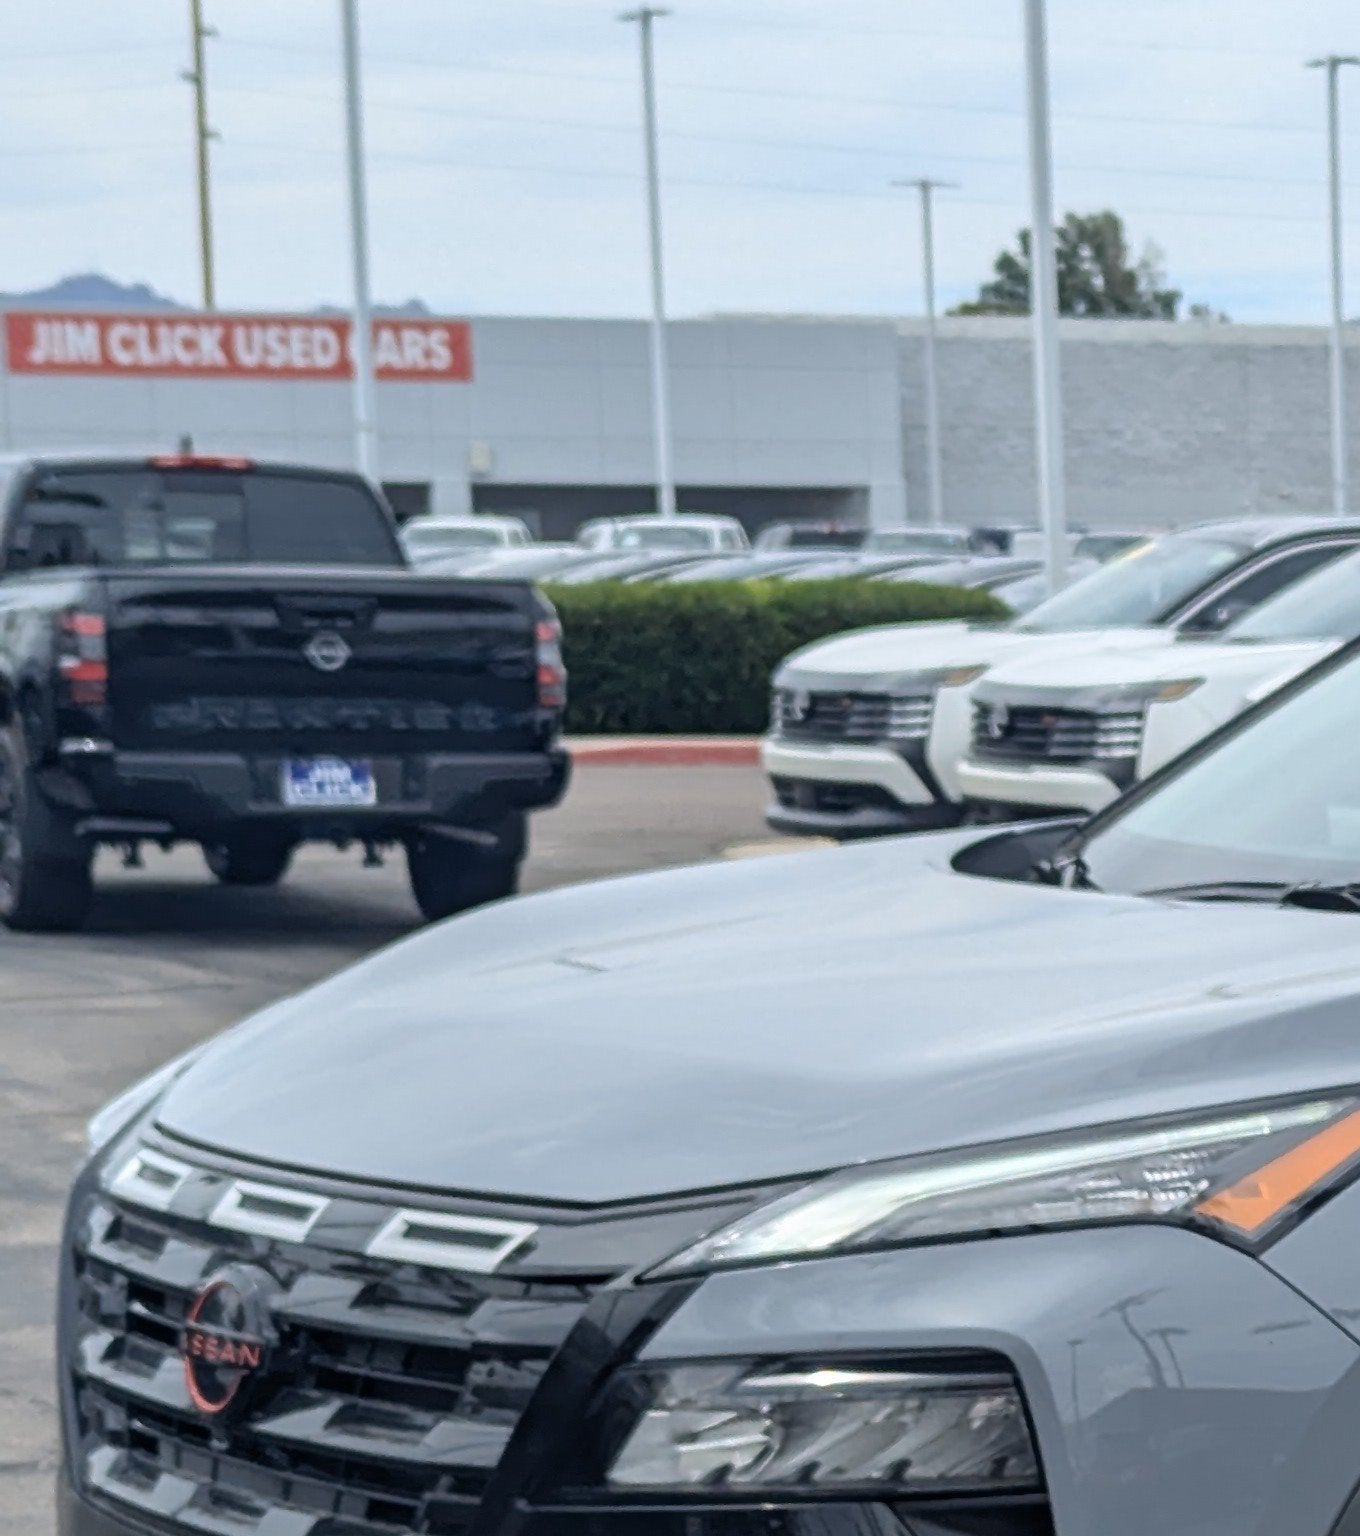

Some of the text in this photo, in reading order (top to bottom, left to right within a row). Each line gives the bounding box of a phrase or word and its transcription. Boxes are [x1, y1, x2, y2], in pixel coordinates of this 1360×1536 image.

[29, 321, 453, 370] JIM CLICK USED ARS
[184, 1331, 261, 1367] SSAN
